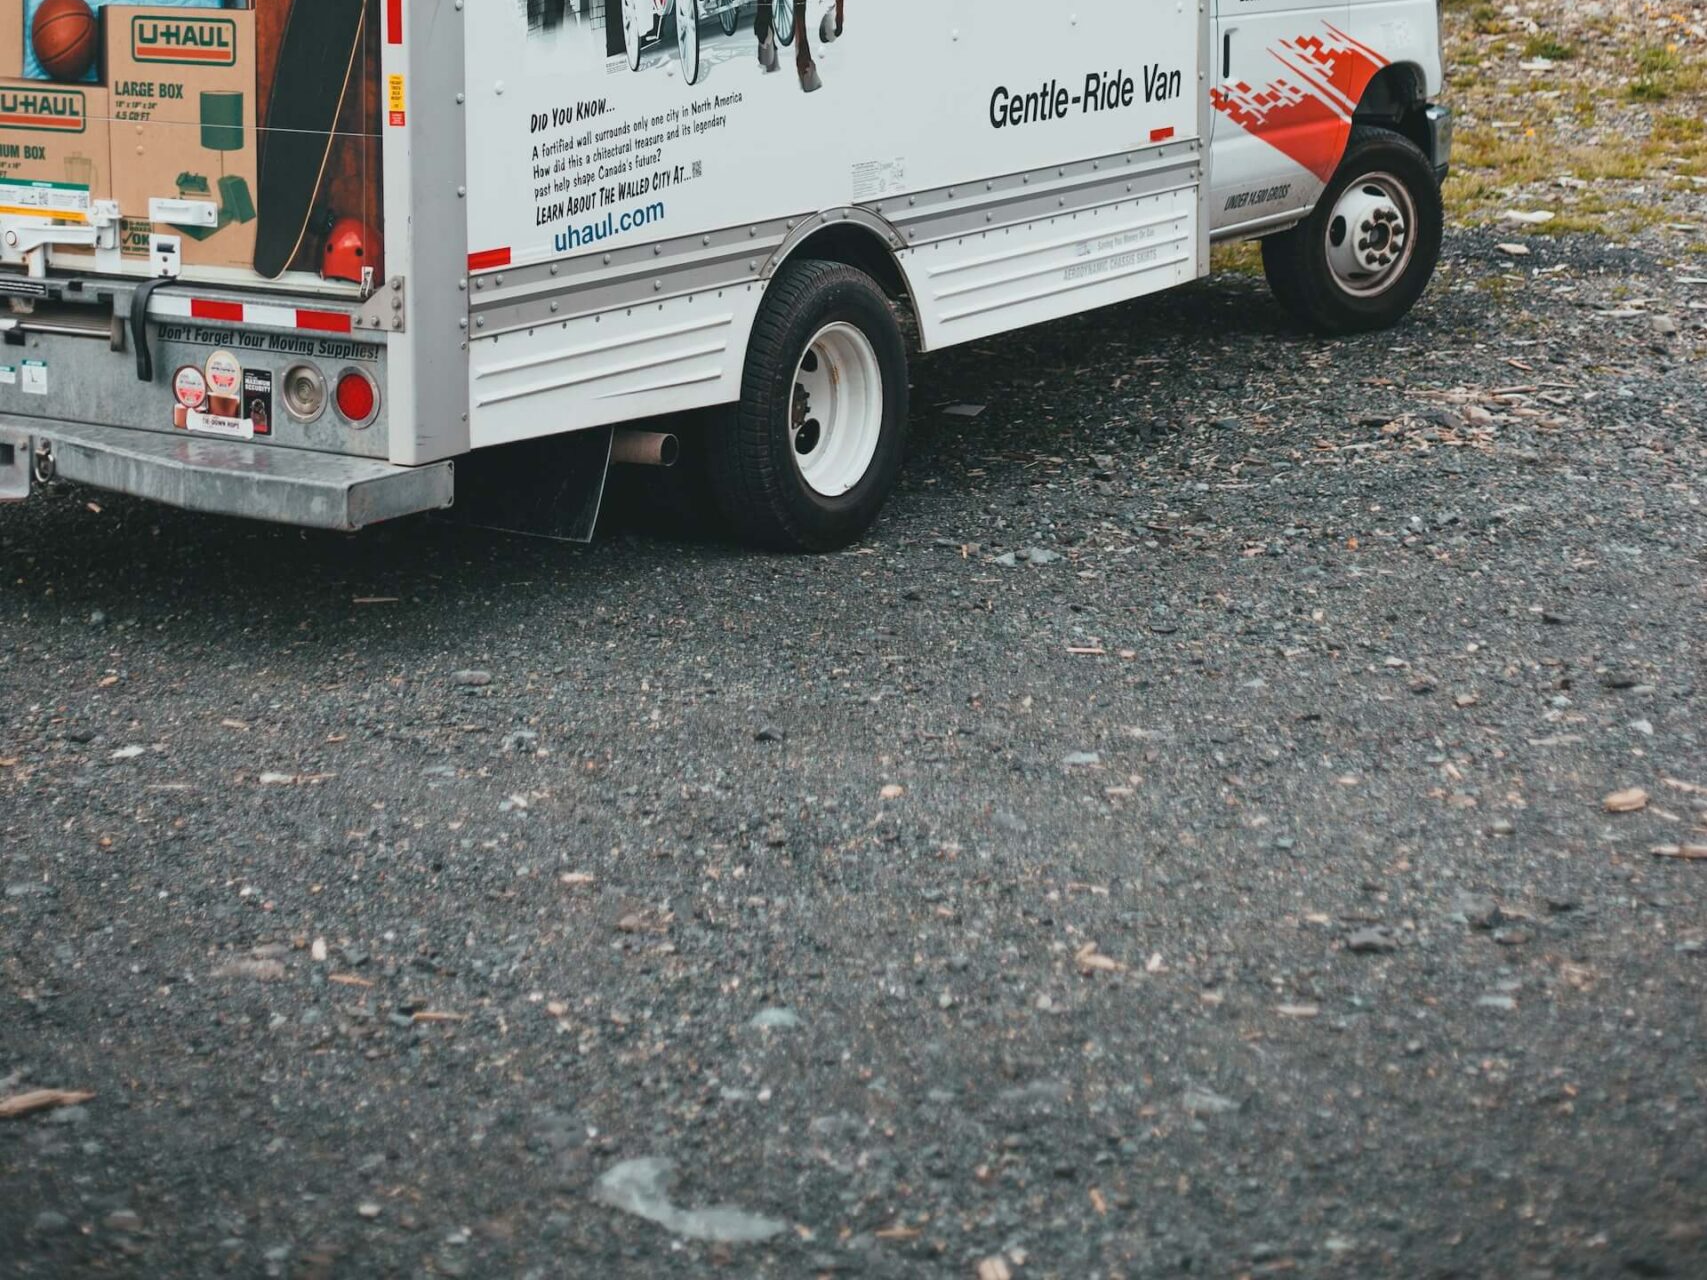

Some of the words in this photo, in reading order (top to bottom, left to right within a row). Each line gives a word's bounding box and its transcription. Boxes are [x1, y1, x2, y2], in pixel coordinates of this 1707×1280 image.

[138, 23, 230, 48] U-HAUL
[0, 93, 80, 117] U-HAUL
[114, 80, 155, 97] LARGE
[158, 82, 184, 99] BOX
[989, 68, 1135, 129] Gentle-Ride
[1143, 65, 1182, 103] Van
[530, 113, 549, 134] DID
[552, 106, 573, 128] YOU
[576, 98, 616, 122] KNOW...
[531, 145, 539, 161] A
[542, 136, 574, 158] fortified
[576, 130, 592, 148] wall
[594, 121, 631, 143] surrounds
[633, 115, 649, 132] only
[651, 115, 664, 127] one
[666, 108, 680, 123] city
[681, 105, 689, 118] in
[691, 97, 712, 116] North
[714, 92, 743, 110] America
[24, 145, 46, 160] BOX
[533, 164, 551, 180] How
[553, 157, 566, 173] did
[568, 154, 583, 170] this
[635, 133, 665, 150] treasure
[666, 124, 680, 141] and
[682, 123, 691, 136] its
[693, 114, 727, 135] legendary
[534, 183, 551, 202] past
[553, 176, 571, 193] help
[573, 172, 596, 187] shape
[598, 159, 633, 180] Canada's
[635, 148, 662, 169] future?
[536, 200, 565, 227] LEARN
[567, 192, 597, 218] ABOUT
[599, 186, 615, 207] THE
[618, 177, 650, 202] WALLED
[652, 170, 671, 192] CITY
[673, 165, 692, 185] AT...
[1224, 191, 1250, 211] UNDER
[1267, 183, 1292, 202] GROSS
[554, 201, 665, 252] uhaul.com
[158, 325, 191, 342] Don't
[194, 328, 234, 346] Forget
[238, 332, 264, 348] Your
[268, 335, 314, 356] Moving
[318, 340, 379, 360] Supplies!
[244, 384, 271, 393] SECURITY
